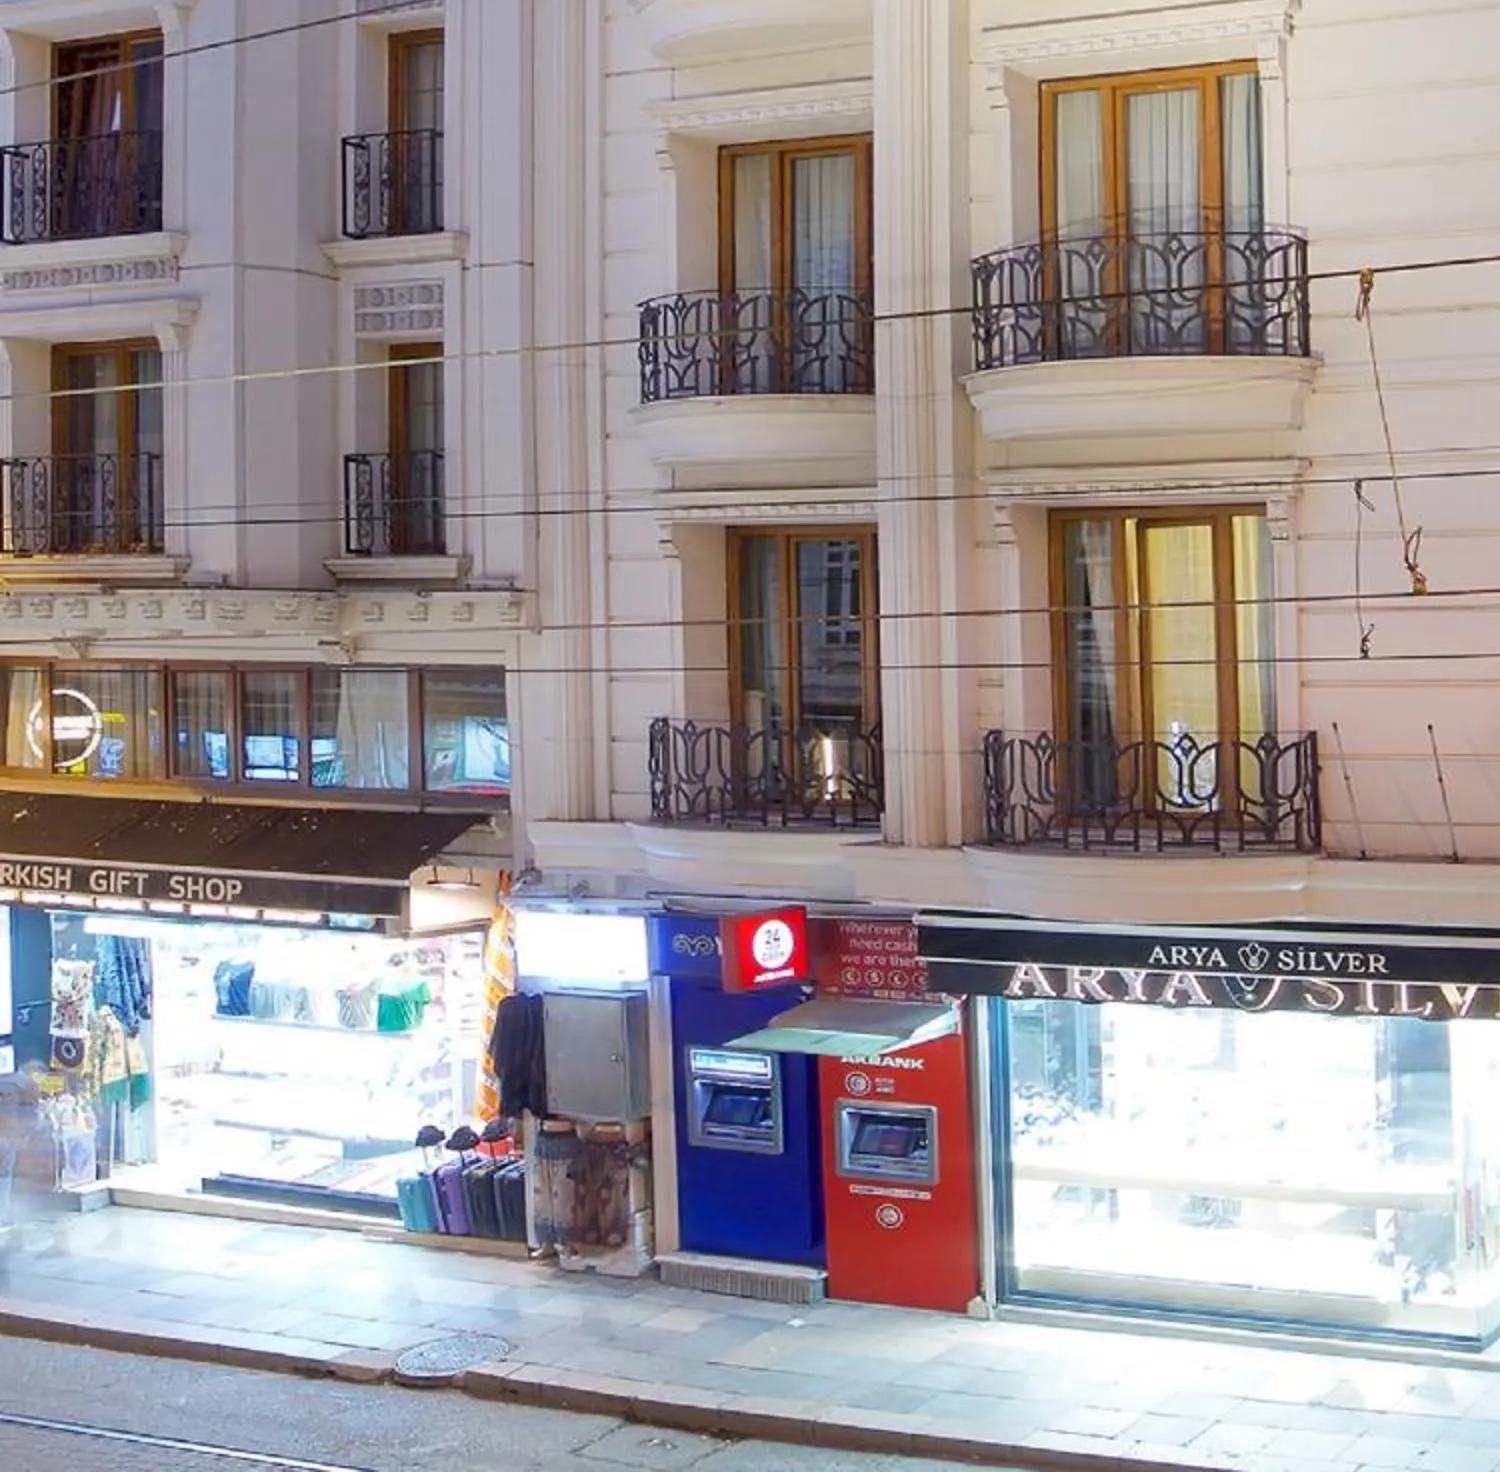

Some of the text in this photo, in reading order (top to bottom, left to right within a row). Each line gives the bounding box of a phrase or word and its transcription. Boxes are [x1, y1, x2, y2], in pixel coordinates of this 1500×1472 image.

[89, 869, 149, 895] GIFT
[169, 875, 242, 901] SHOP
[1148, 946, 1389, 974] ARYA SİLVER
